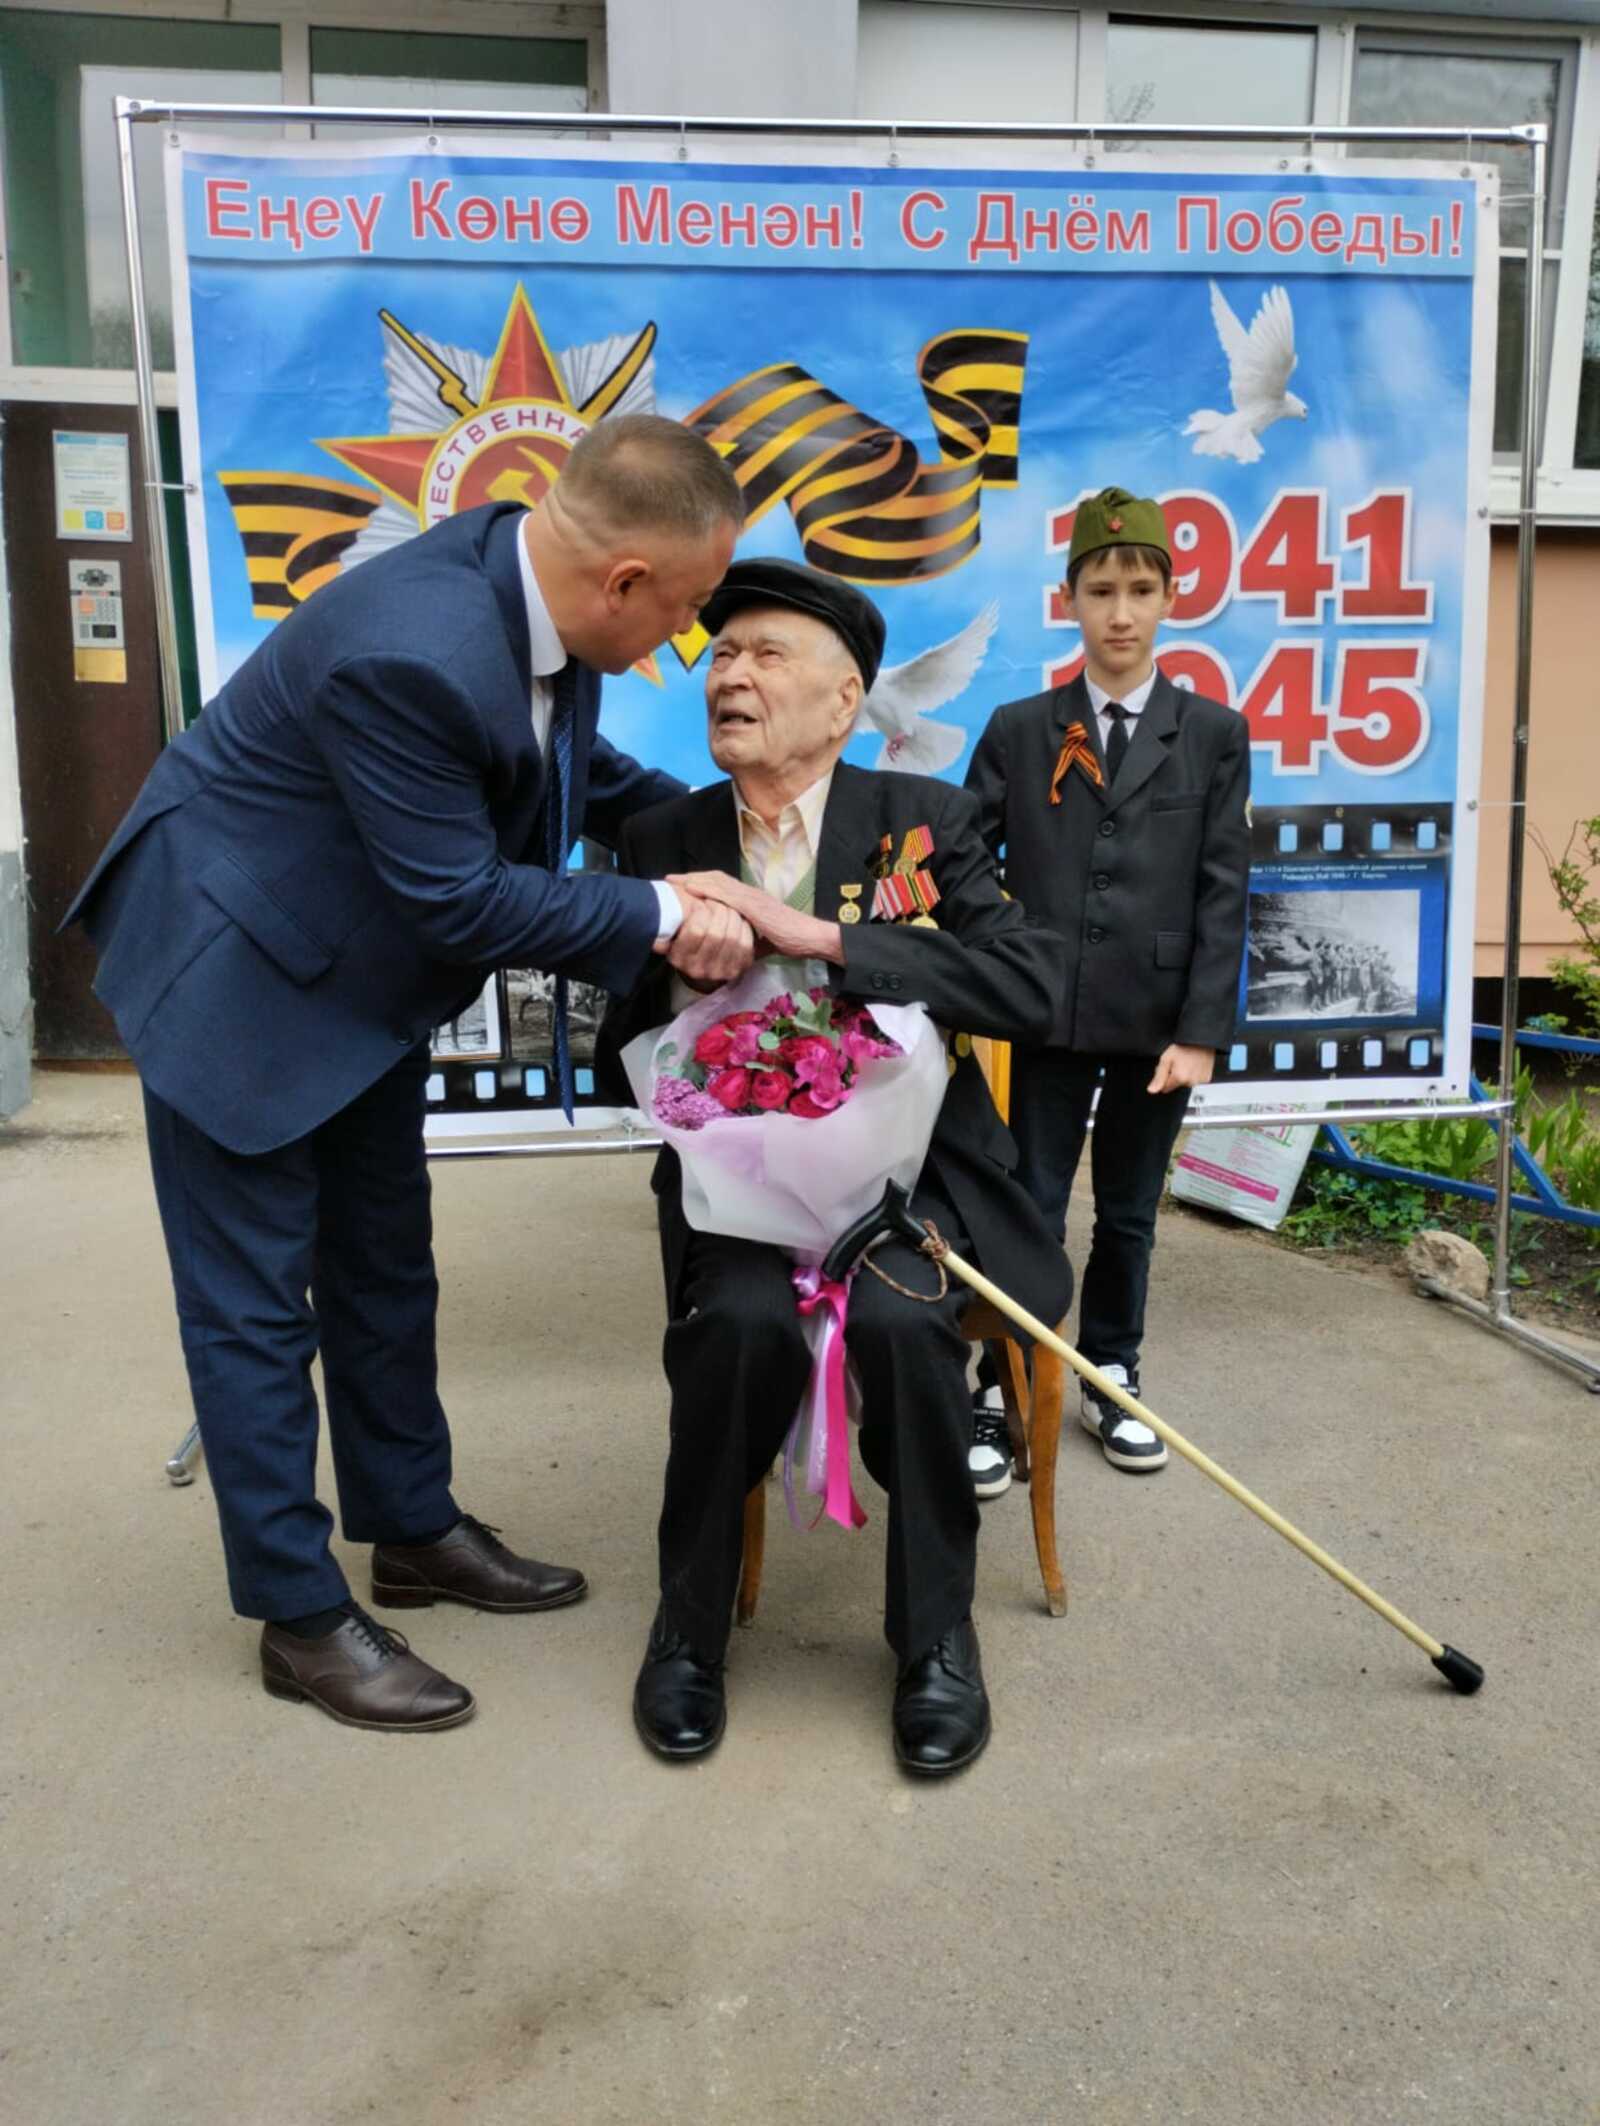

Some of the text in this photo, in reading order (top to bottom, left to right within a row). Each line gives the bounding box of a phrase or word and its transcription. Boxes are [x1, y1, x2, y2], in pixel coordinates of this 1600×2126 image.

[204, 178, 1463, 264] Еңеү Көнө Менән! С Днём Победы!
